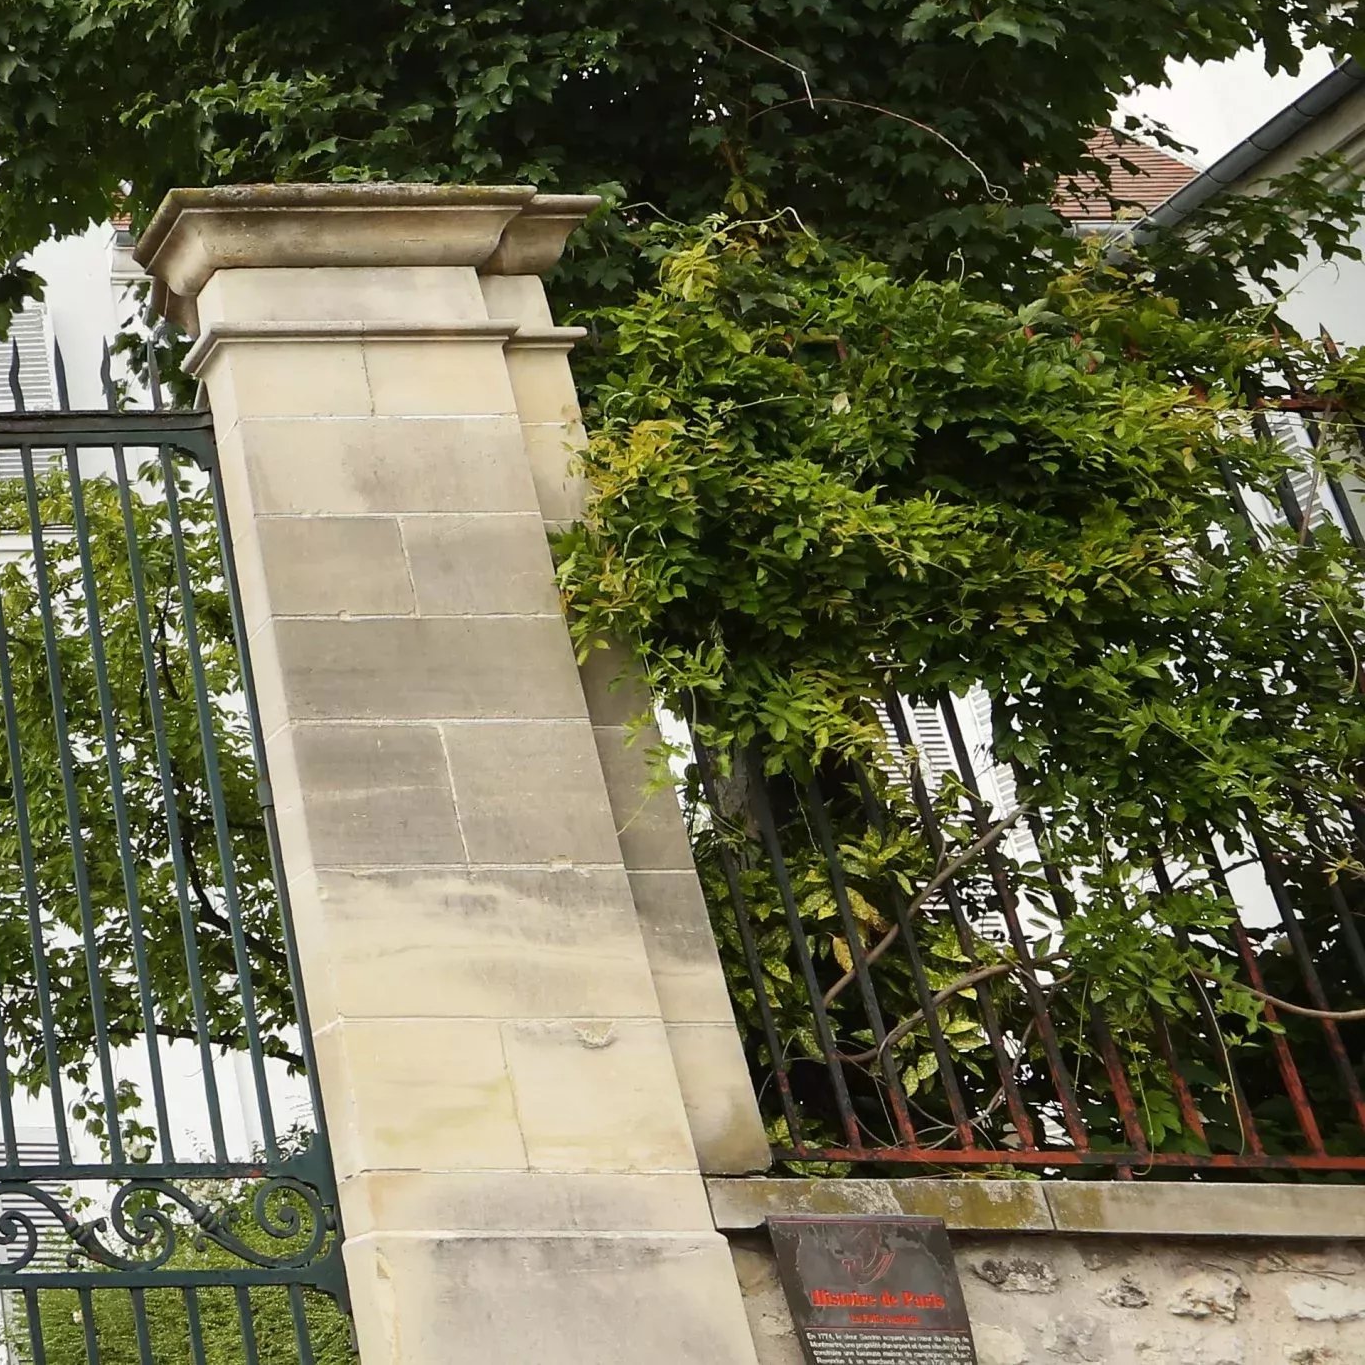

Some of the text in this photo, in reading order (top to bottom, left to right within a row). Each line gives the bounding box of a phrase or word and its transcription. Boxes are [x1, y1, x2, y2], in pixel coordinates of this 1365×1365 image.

[811, 1289, 945, 1309] Histoire de Paris
